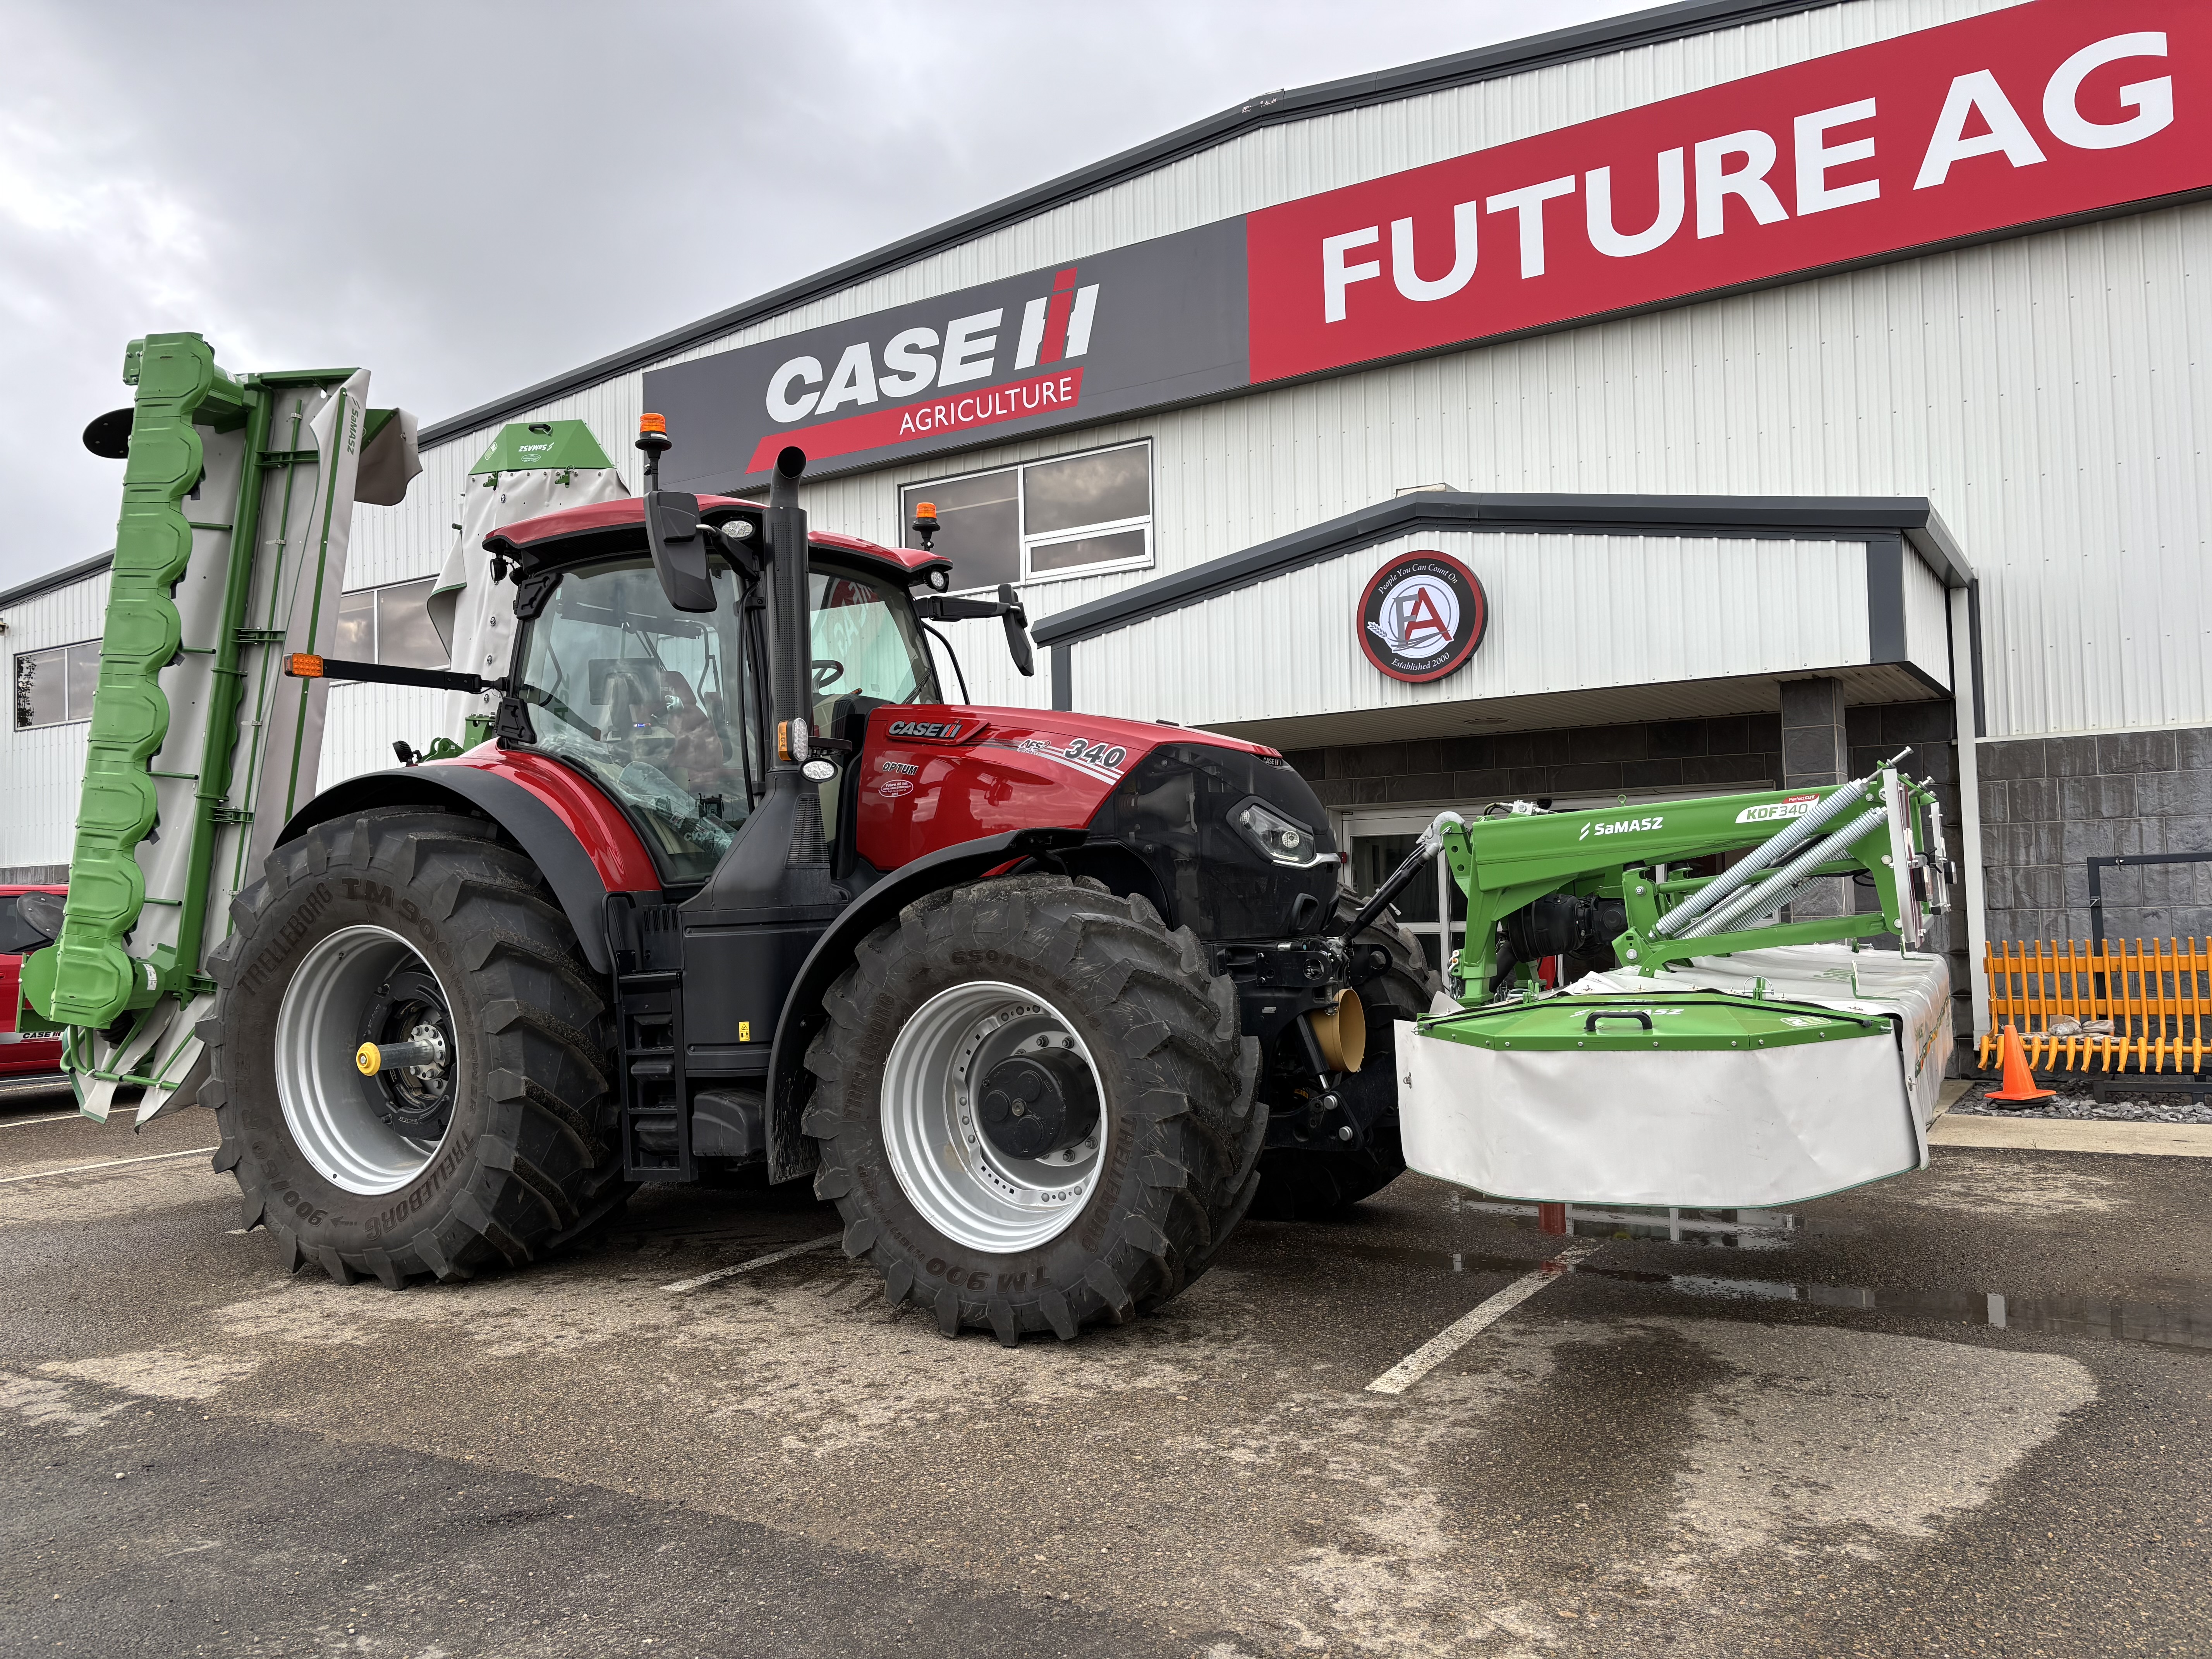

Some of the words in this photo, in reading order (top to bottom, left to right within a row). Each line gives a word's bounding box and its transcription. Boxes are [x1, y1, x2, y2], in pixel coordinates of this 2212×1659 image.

[1322, 97, 1881, 324] FUTURE
[1912, 31, 2174, 191] AG
[766, 307, 1003, 423] CASE
[899, 377, 1072, 435] AGRICULTURE
[347, 408, 359, 455] SaMASZ
[1377, 575, 1398, 594] People
[1397, 567, 1410, 577] You
[1428, 563, 1448, 577] Count
[1448, 573, 1458, 584] On
[1391, 658, 1431, 671] Established
[1432, 652, 1449, 667] 2000
[889, 721, 943, 737] CASE
[1019, 739, 1044, 750] AFS
[883, 761, 919, 775] OPTUM
[1063, 738, 1127, 768] 340
[1594, 817, 1663, 835] SaMASZ
[237, 881, 333, 996] TRELLEBORG
[341, 877, 393, 909] TM
[398, 897, 455, 968] 900
[951, 949, 1047, 979] 650/60
[842, 992, 894, 1118] TRELLEBORG
[364, 1130, 475, 1241] TRELLEBORG
[1081, 1116, 1137, 1254] TRELLEBORG
[890, 1226, 925, 1261] HIGH
[926, 1257, 991, 1291] 900
[995, 1265, 1051, 1294] TM
